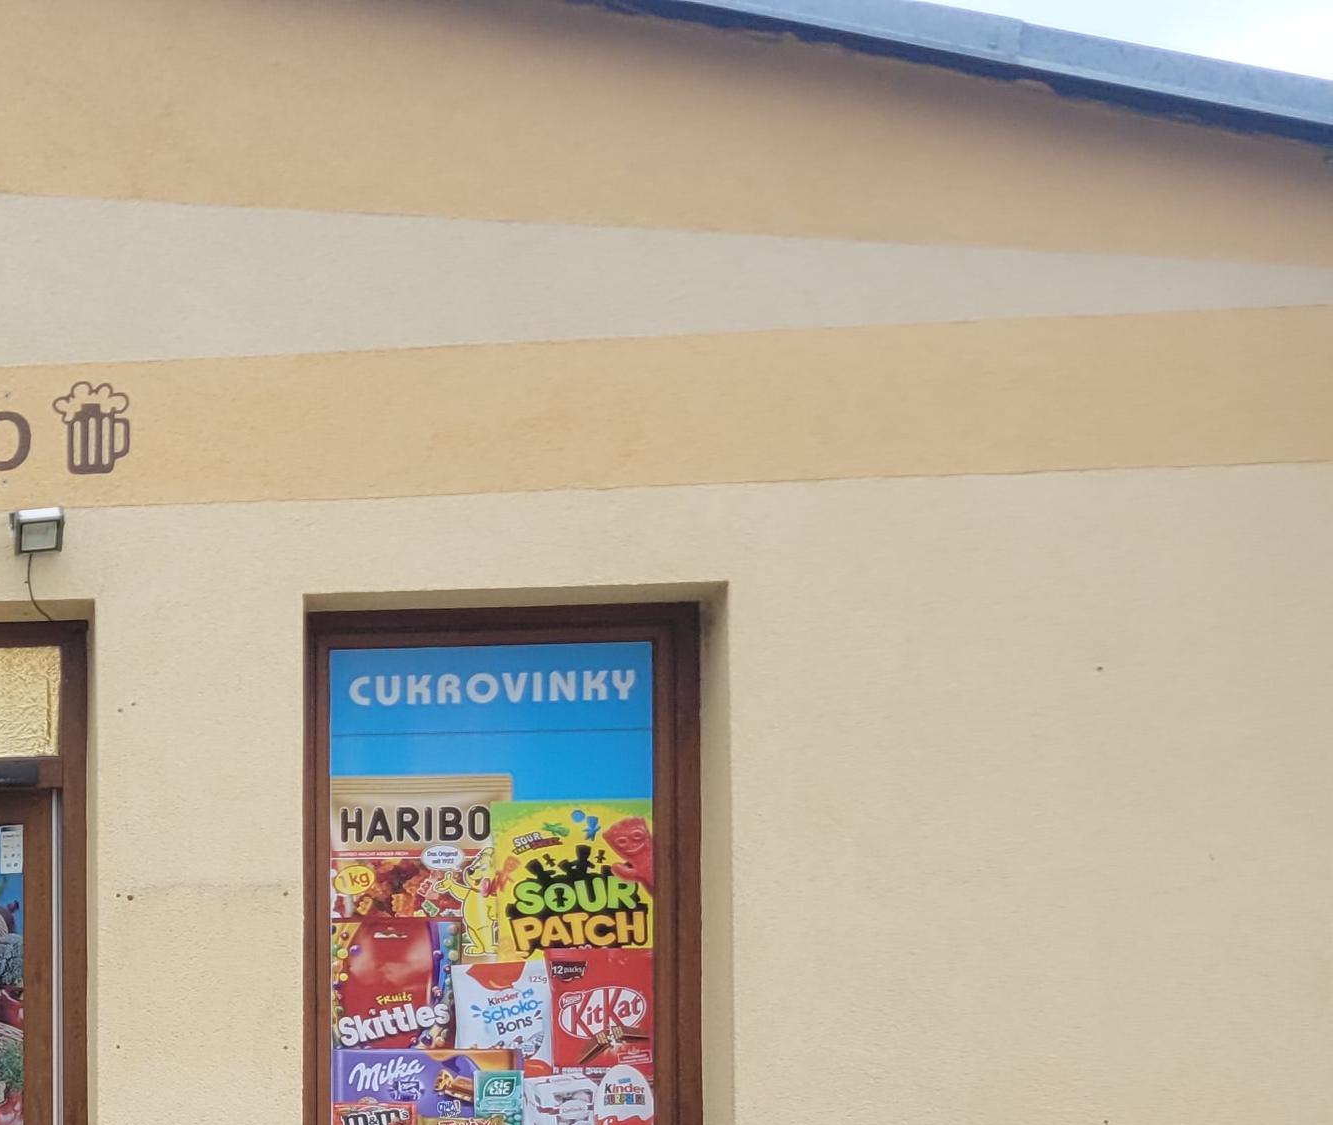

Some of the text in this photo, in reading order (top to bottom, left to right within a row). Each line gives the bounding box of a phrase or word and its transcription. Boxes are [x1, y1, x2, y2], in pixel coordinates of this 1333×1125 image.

[348, 669, 636, 707] CUKROVINKY
[340, 805, 491, 843] HARIBO
[513, 831, 542, 847] SOUR
[349, 870, 370, 887] kg
[514, 875, 637, 915] SOUR
[512, 911, 646, 951] PATCH
[551, 965, 564, 975] 12
[338, 1003, 451, 1047] Skittles
[496, 1016, 533, 1035] Bons
[569, 988, 642, 1037] KitKat
[348, 1056, 426, 1092] Milka
[488, 1087, 511, 1096] tac
[492, 1079, 512, 1089] tic
